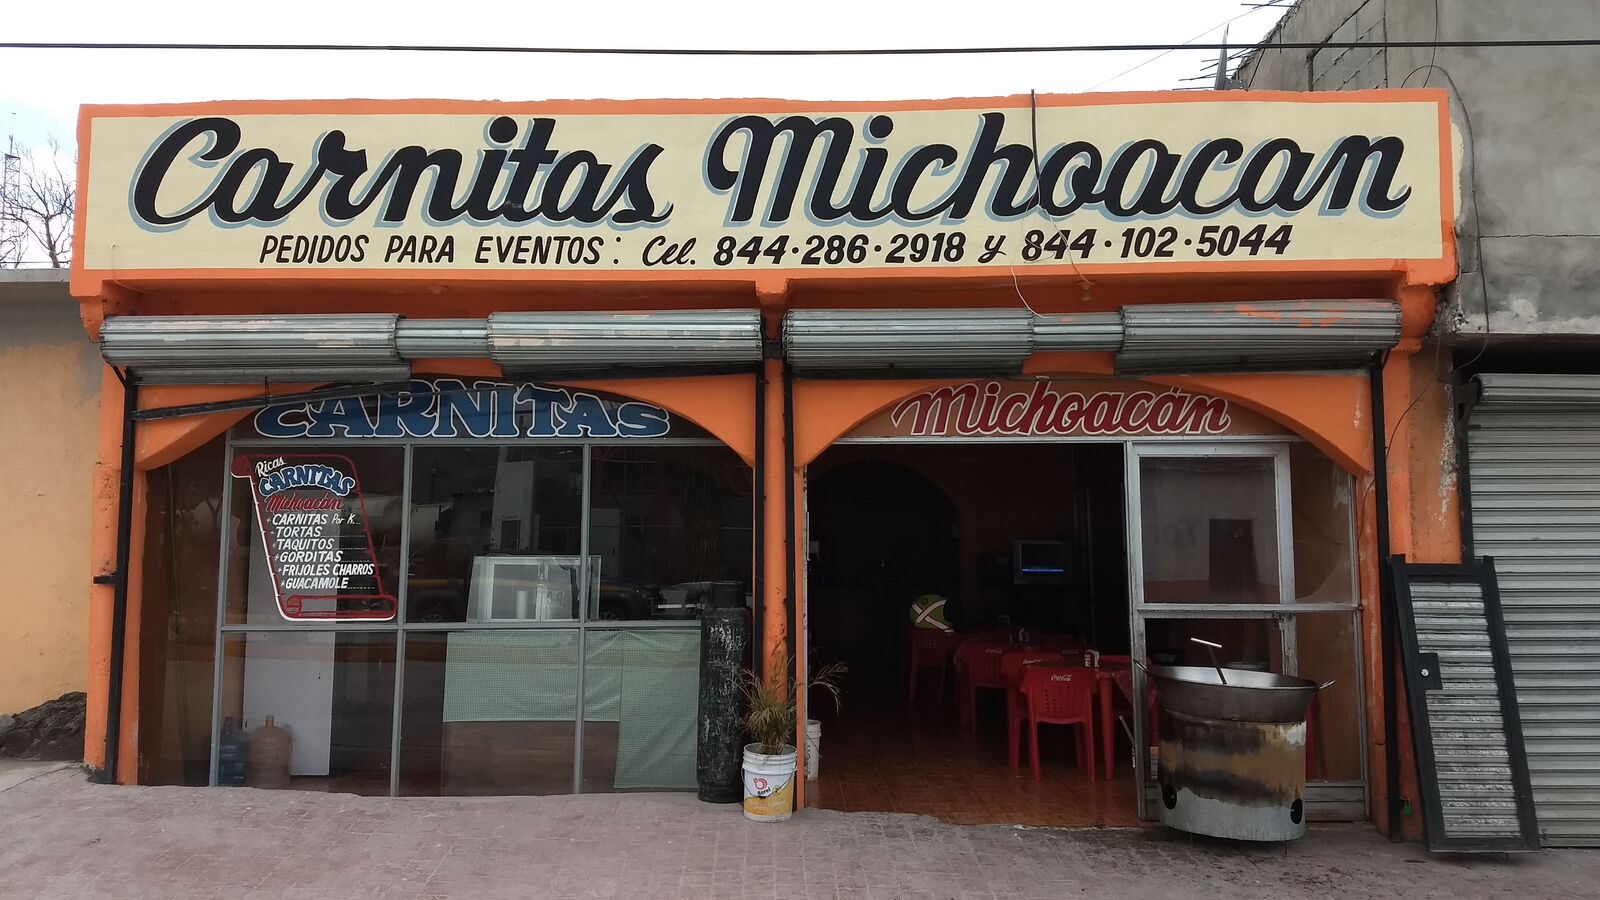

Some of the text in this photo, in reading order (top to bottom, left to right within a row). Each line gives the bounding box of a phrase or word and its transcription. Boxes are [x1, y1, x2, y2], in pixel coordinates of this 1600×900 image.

[130, 111, 1412, 228] Carnitas Michoacan
[259, 234, 370, 264] PEDIDOS
[383, 234, 455, 264] PARA
[641, 235, 697, 266] Cel.
[253, 377, 672, 438] CARNITAS
[255, 456, 287, 478] Ricas
[259, 464, 356, 497] CARNITAS
[272, 513, 329, 526] CARNITAS
[275, 526, 323, 538] TORTAS
[276, 538, 335, 551] TAQUITOS
[279, 550, 344, 563] GORDITAS
[281, 563, 375, 576] FRIJOLES CHARROS
[285, 577, 350, 589] GUACAMOLE
